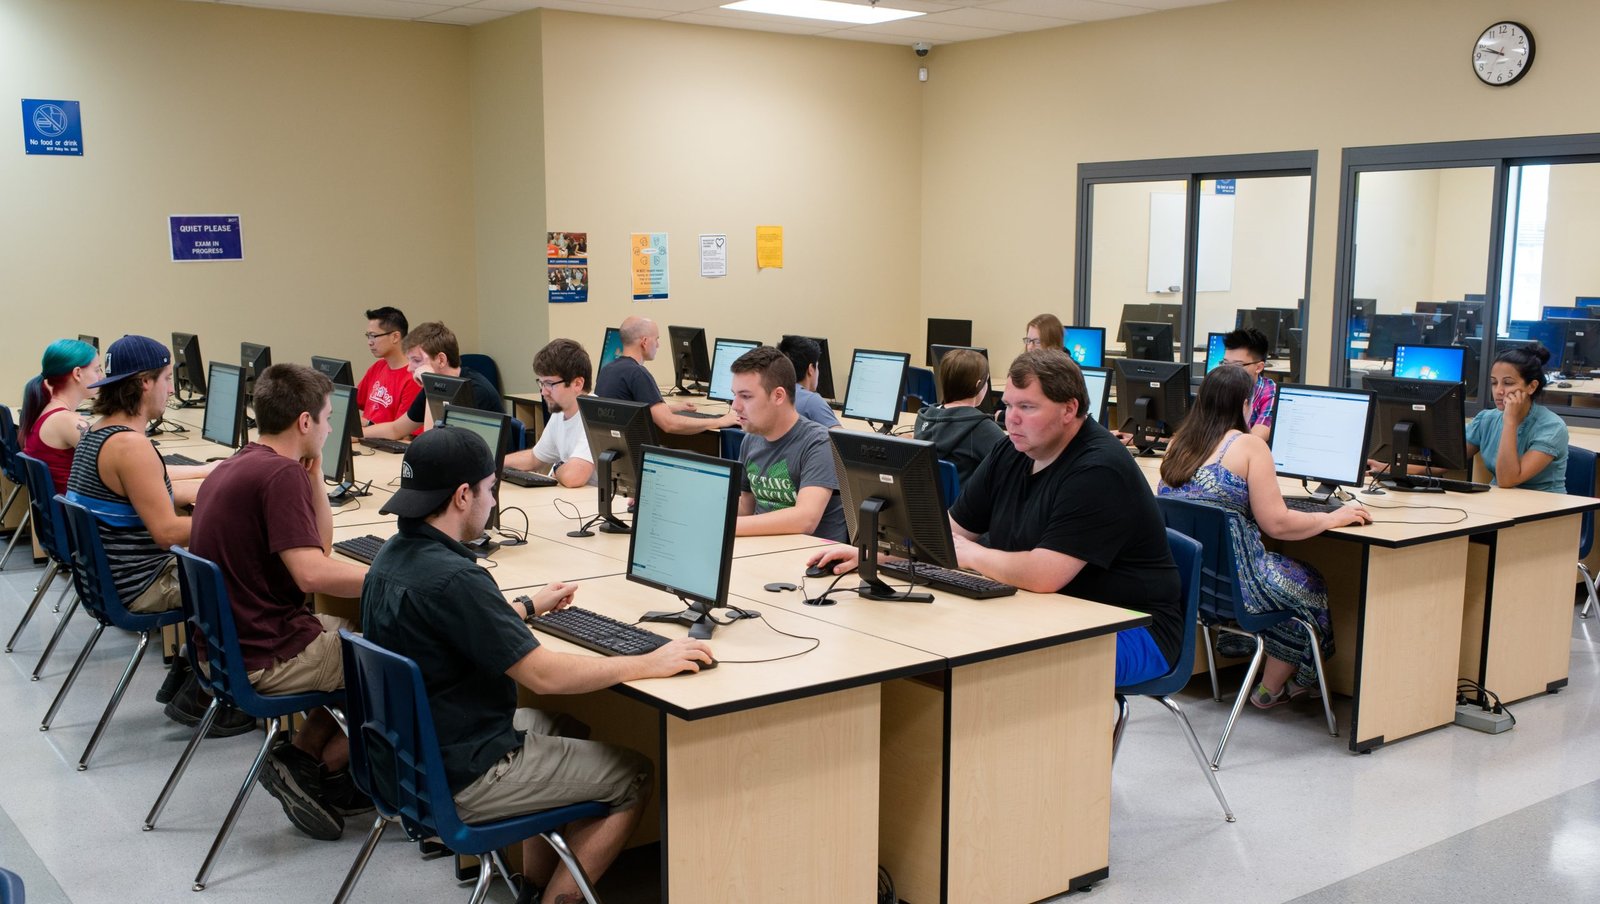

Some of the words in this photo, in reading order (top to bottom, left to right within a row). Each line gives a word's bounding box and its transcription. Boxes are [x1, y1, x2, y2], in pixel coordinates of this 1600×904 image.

[1499, 25, 1507, 34] 12
[1489, 31, 1495, 39] 11
[1518, 36, 1524, 44] 2
[1521, 47, 1527, 56] 3
[1476, 52, 1482, 61] 9
[1479, 63, 1484, 71] 8
[1517, 59, 1522, 68] 4
[1487, 71, 1492, 80] 7
[1497, 73, 1502, 82] 6
[1508, 69, 1513, 78] 5
